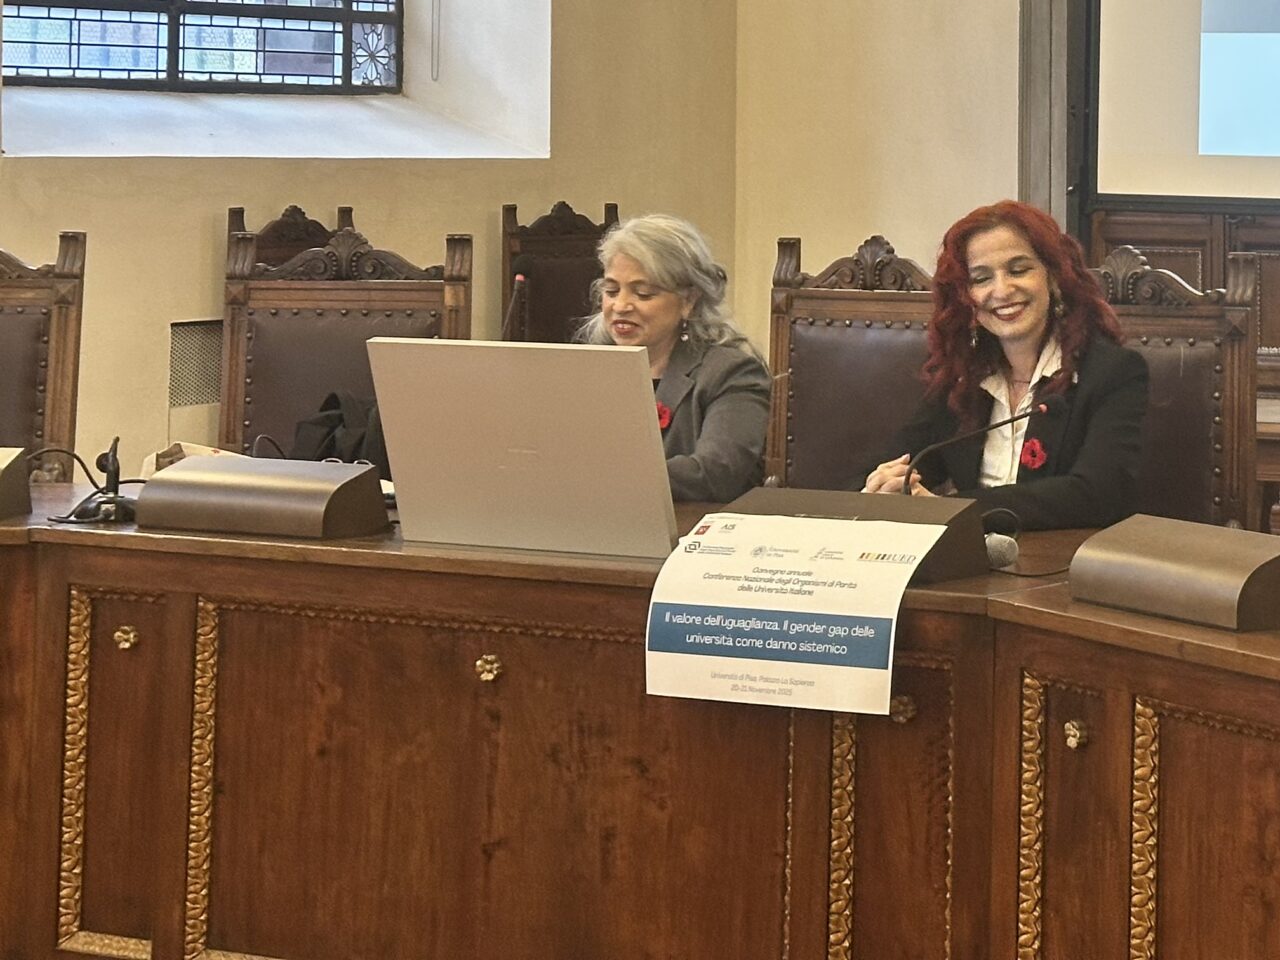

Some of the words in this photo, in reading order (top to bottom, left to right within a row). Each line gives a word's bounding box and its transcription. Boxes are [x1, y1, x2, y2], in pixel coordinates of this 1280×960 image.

[752, 567, 786, 576] Convegno
[702, 572, 742, 581] Conferenza
[743, 575, 774, 583] Nazionale
[775, 578, 791, 586] degli
[792, 578, 827, 587] Organismi
[737, 584, 753, 592] delle
[789, 586, 814, 596] Italiane
[665, 611, 671, 622] Il
[671, 613, 702, 625] valore
[783, 620, 789, 630] Il
[789, 622, 825, 635] gender
[828, 625, 848, 638] gap
[851, 625, 875, 638] delle
[686, 632, 733, 646] università
[735, 637, 763, 648] come
[765, 637, 797, 651] danno
[799, 642, 847, 655] sistemico
